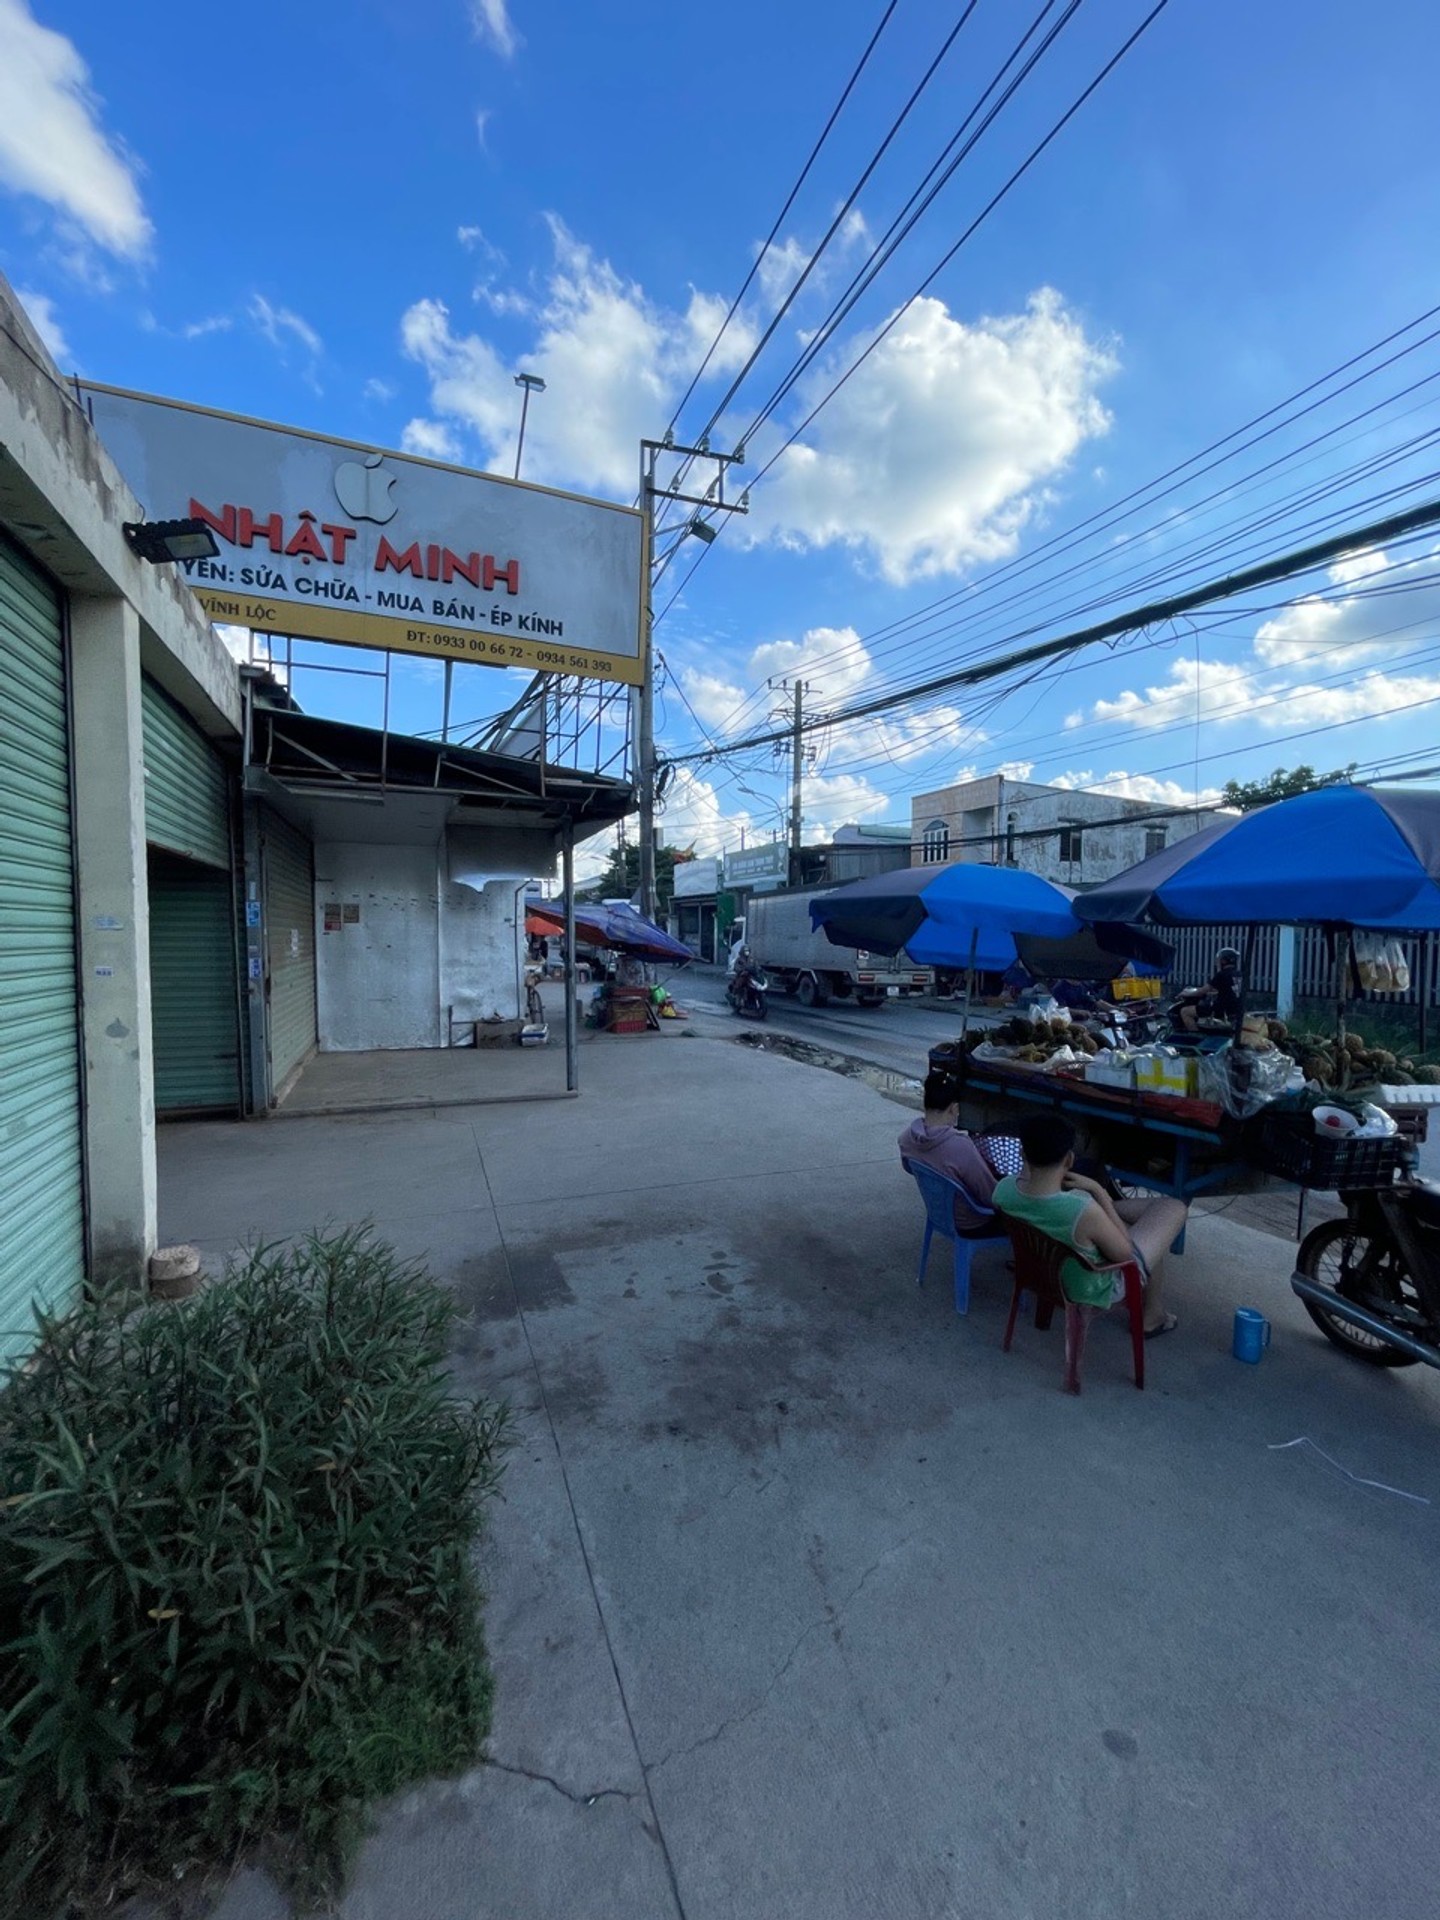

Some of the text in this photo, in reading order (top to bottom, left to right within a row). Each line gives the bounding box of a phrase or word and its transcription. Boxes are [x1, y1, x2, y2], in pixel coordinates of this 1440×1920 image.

[189, 497, 519, 596] NHẬT MINH
[175, 556, 234, 583] YÊN:
[240, 564, 288, 591] SỬA
[294, 577, 360, 602] CHỮA
[377, 590, 425, 613] MUA
[432, 598, 475, 621] BÁN
[491, 604, 513, 627] ÉP
[518, 611, 563, 637] KÍNH
[200, 597, 277, 621] VĨNH LỘC
[407, 630, 431, 644] ĐT:
[433, 633, 465, 649] 0933
[469, 639, 486, 652] 00
[490, 643, 506, 655] 66
[509, 646, 523, 658] 72
[536, 650, 565, 665] 0934
[569, 655, 589, 669] 561
[592, 660, 612, 673] 393
